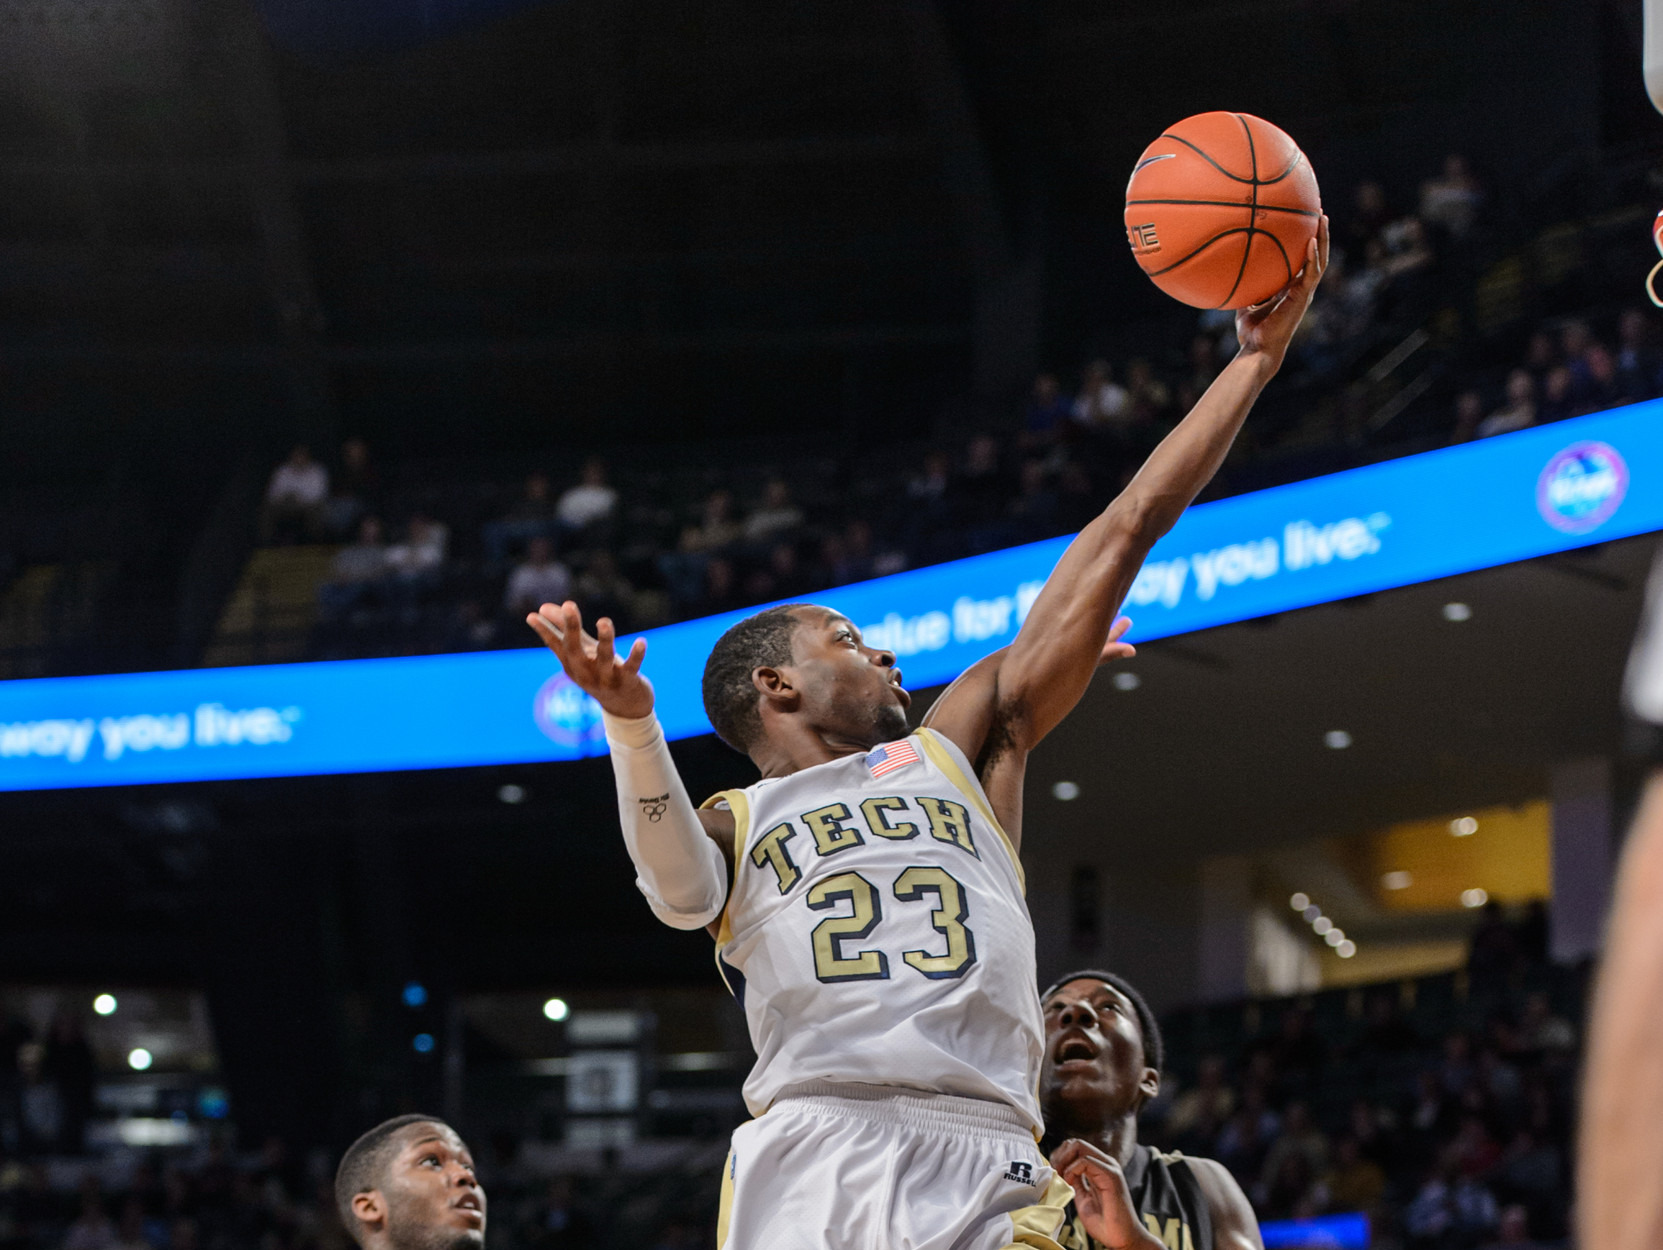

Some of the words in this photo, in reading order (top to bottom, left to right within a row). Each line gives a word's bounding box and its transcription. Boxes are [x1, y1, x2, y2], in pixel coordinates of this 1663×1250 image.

[1121, 556, 1188, 609] ay
[1191, 537, 1280, 601] you
[99, 714, 191, 762] you
[750, 797, 981, 896] TECH
[806, 866, 978, 984] 23
